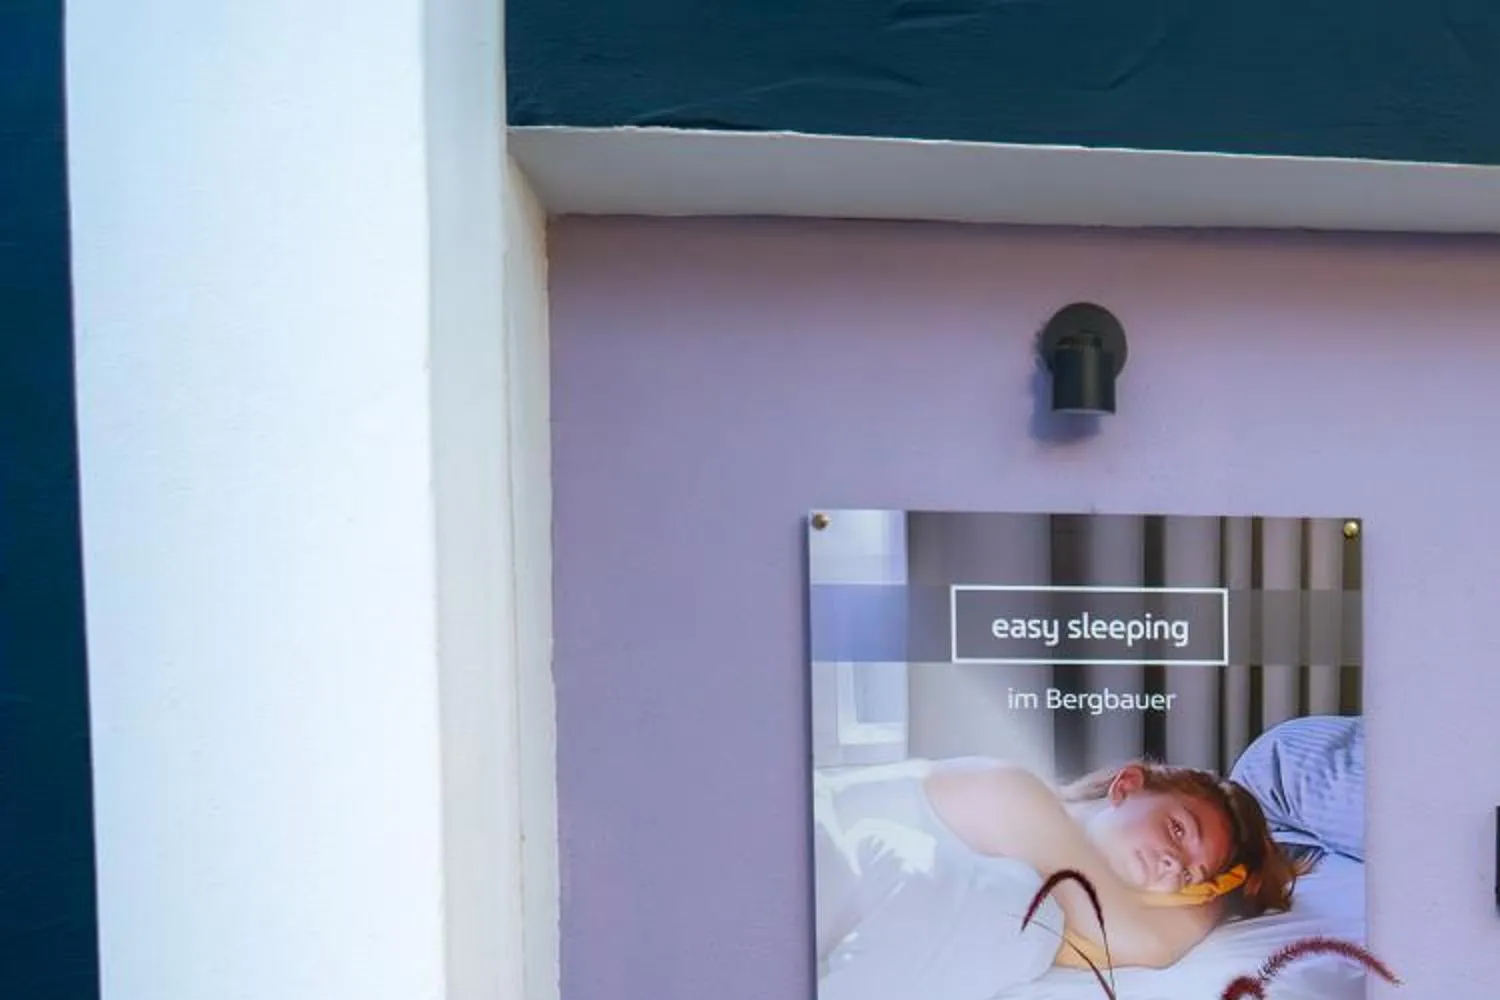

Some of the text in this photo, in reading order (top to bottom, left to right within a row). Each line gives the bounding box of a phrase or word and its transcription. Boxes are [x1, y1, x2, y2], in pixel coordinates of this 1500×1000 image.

[992, 612, 1189, 647] easy sleeping
[1007, 687, 1177, 715] im Bergbauer
